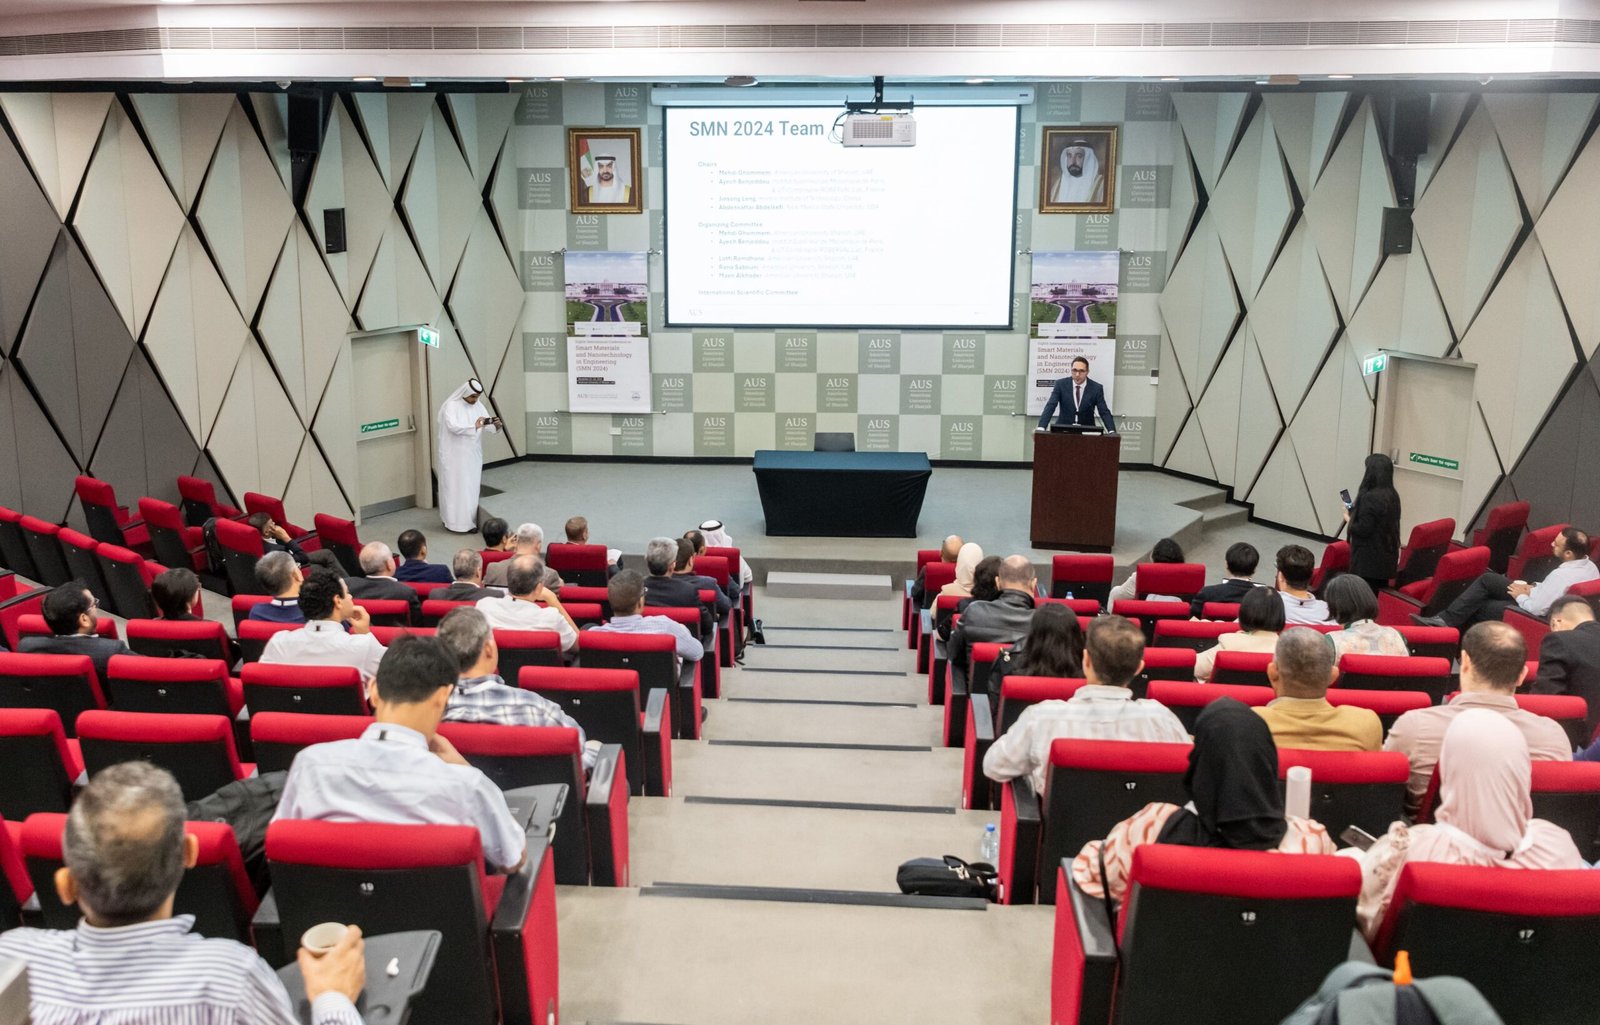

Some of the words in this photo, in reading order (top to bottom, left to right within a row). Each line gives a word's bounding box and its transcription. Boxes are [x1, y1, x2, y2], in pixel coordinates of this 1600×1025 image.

[616, 88, 637, 97] AUS
[1048, 84, 1072, 94] AUS
[690, 121, 729, 136] SMN
[734, 121, 773, 136] 2024
[778, 120, 824, 136] Team
[529, 174, 551, 183] AUS
[1133, 171, 1156, 180] AUS
[576, 216, 598, 224] AUS
[1086, 215, 1109, 224] AUS
[531, 257, 553, 265] AUS
[1128, 257, 1151, 266] AUS
[534, 338, 556, 347] AUS
[703, 338, 724, 347] AUS
[786, 338, 807, 347] AUS
[869, 339, 891, 348] AUS
[953, 339, 975, 348] AUS
[1124, 341, 1147, 349] AUS
[662, 379, 684, 387] AUS
[744, 378, 766, 387] AUS
[827, 378, 848, 387] AUS
[910, 380, 932, 389] AUS
[994, 380, 1016, 389] AUS
[537, 417, 558, 426] AUS
[623, 418, 644, 427] AUS
[704, 418, 725, 426] AUS
[785, 418, 807, 427] AUS
[868, 420, 889, 429] AUS
[951, 423, 973, 432] AUS
[1119, 422, 1142, 431] AUS
[1125, 782, 1136, 790] 17
[360, 882, 374, 891] 19
[1242, 912, 1256, 921] 18
[1519, 930, 1534, 940] 17
